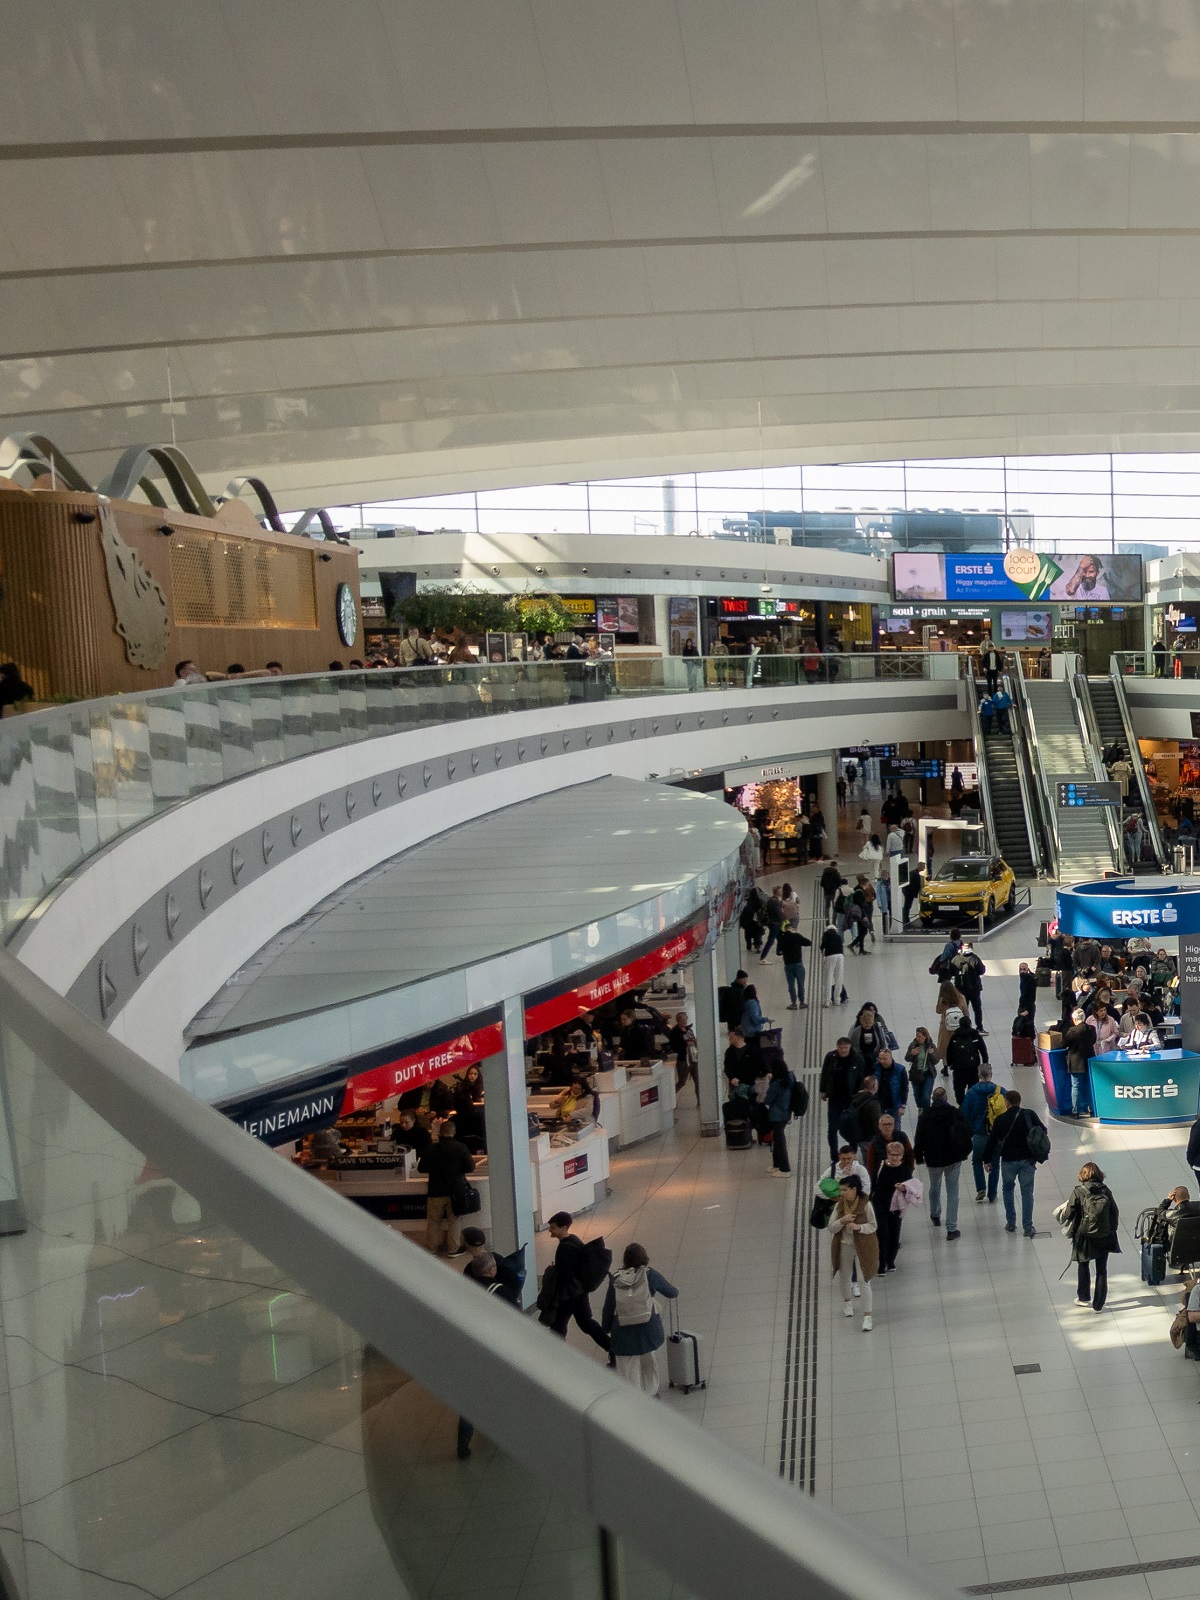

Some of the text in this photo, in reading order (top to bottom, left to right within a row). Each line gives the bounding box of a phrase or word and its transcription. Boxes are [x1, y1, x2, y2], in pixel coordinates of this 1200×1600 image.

[1009, 553, 1034, 564] food
[955, 565, 983, 574] ERSTE
[1008, 565, 1037, 575] court
[723, 600, 748, 612] TWIST
[892, 606, 947, 618] soul grain
[1112, 909, 1160, 925] ERSTE
[590, 972, 630, 1000] TRAVEL VALUE
[395, 1051, 453, 1084] DUTY FREE
[1114, 1085, 1161, 1099] ERSTE
